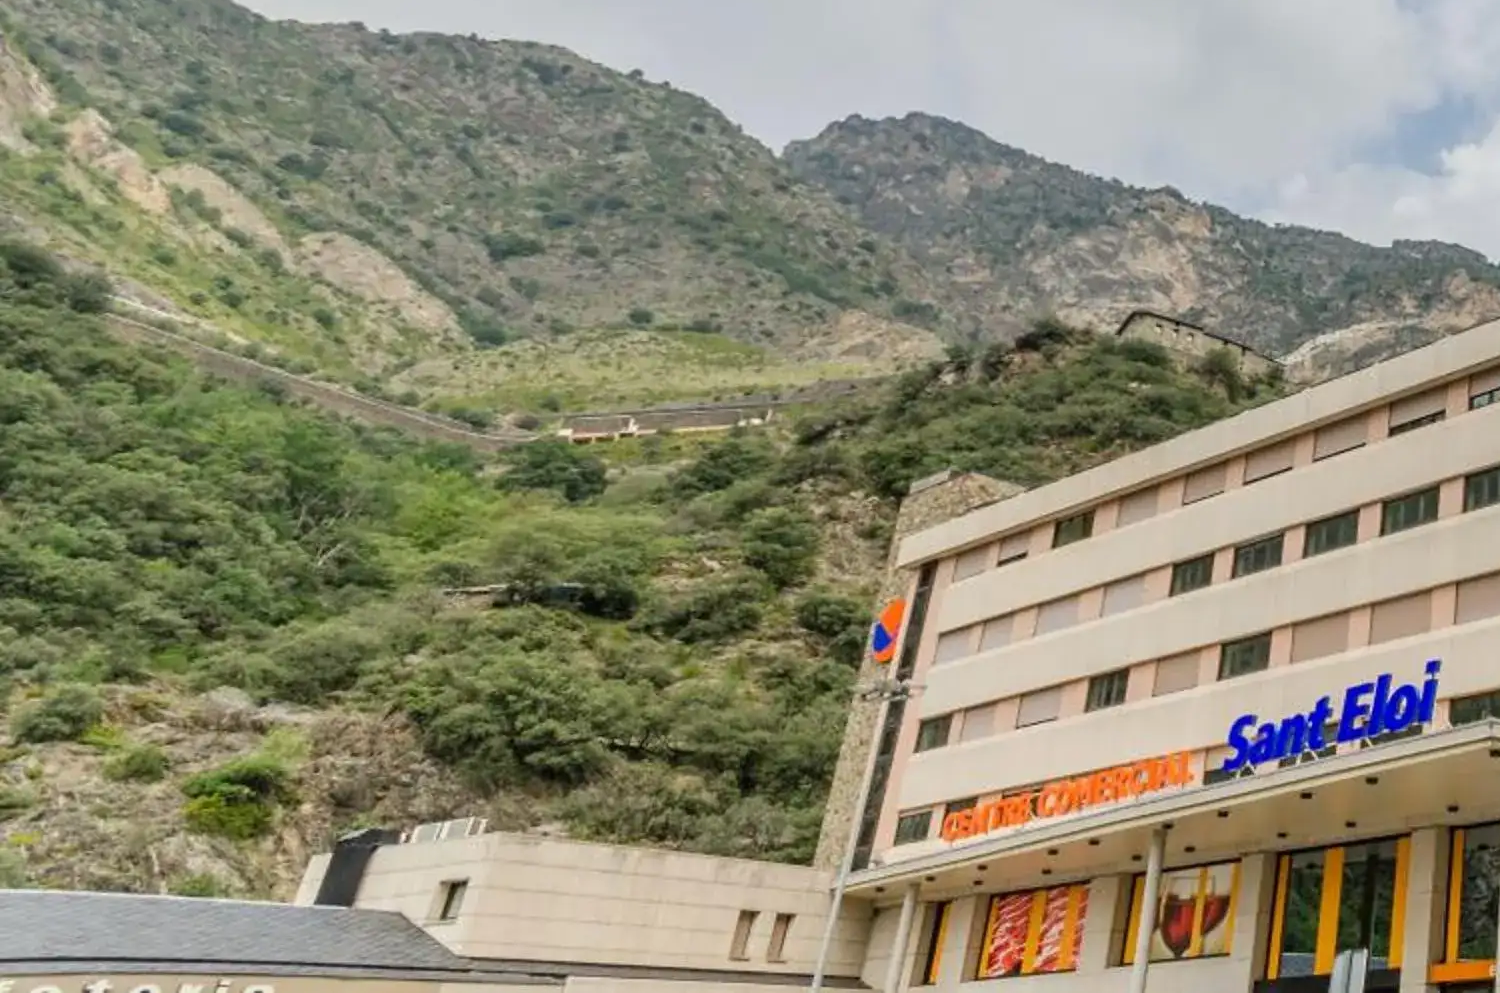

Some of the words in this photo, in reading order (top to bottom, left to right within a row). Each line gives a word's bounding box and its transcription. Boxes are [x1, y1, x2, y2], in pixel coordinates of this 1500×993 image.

[1221, 696, 1334, 773] Sant
[1336, 659, 1442, 744] Eloi
[941, 791, 1034, 843] CENTRE
[1036, 750, 1194, 818] COMERCIAL
